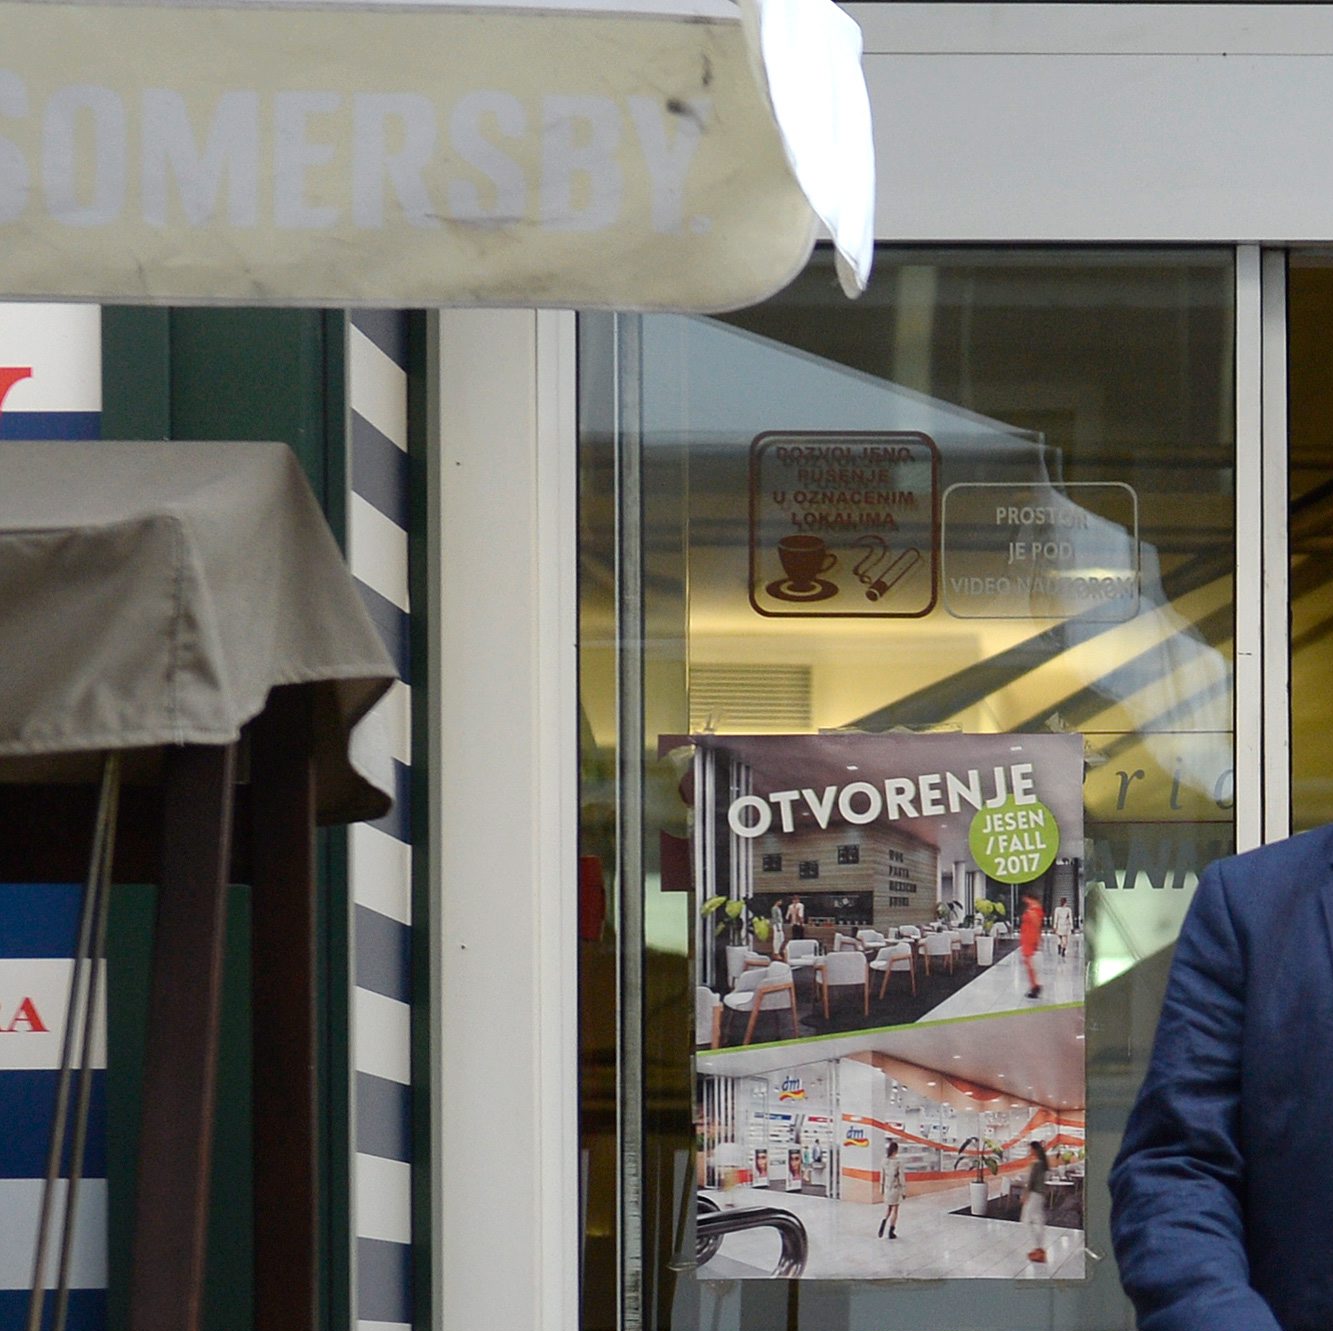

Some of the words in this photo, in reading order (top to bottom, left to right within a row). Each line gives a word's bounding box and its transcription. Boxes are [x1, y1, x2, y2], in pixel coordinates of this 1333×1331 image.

[772, 490, 786, 505] U
[791, 512, 896, 527] LOKALIMA
[1007, 542, 1026, 565] JE
[1032, 542, 1073, 560] POD
[950, 576, 1011, 595] VIDEO
[727, 763, 1037, 838] OTVORENJE
[982, 809, 1044, 833] JESEN
[994, 853, 1040, 876] 2017
